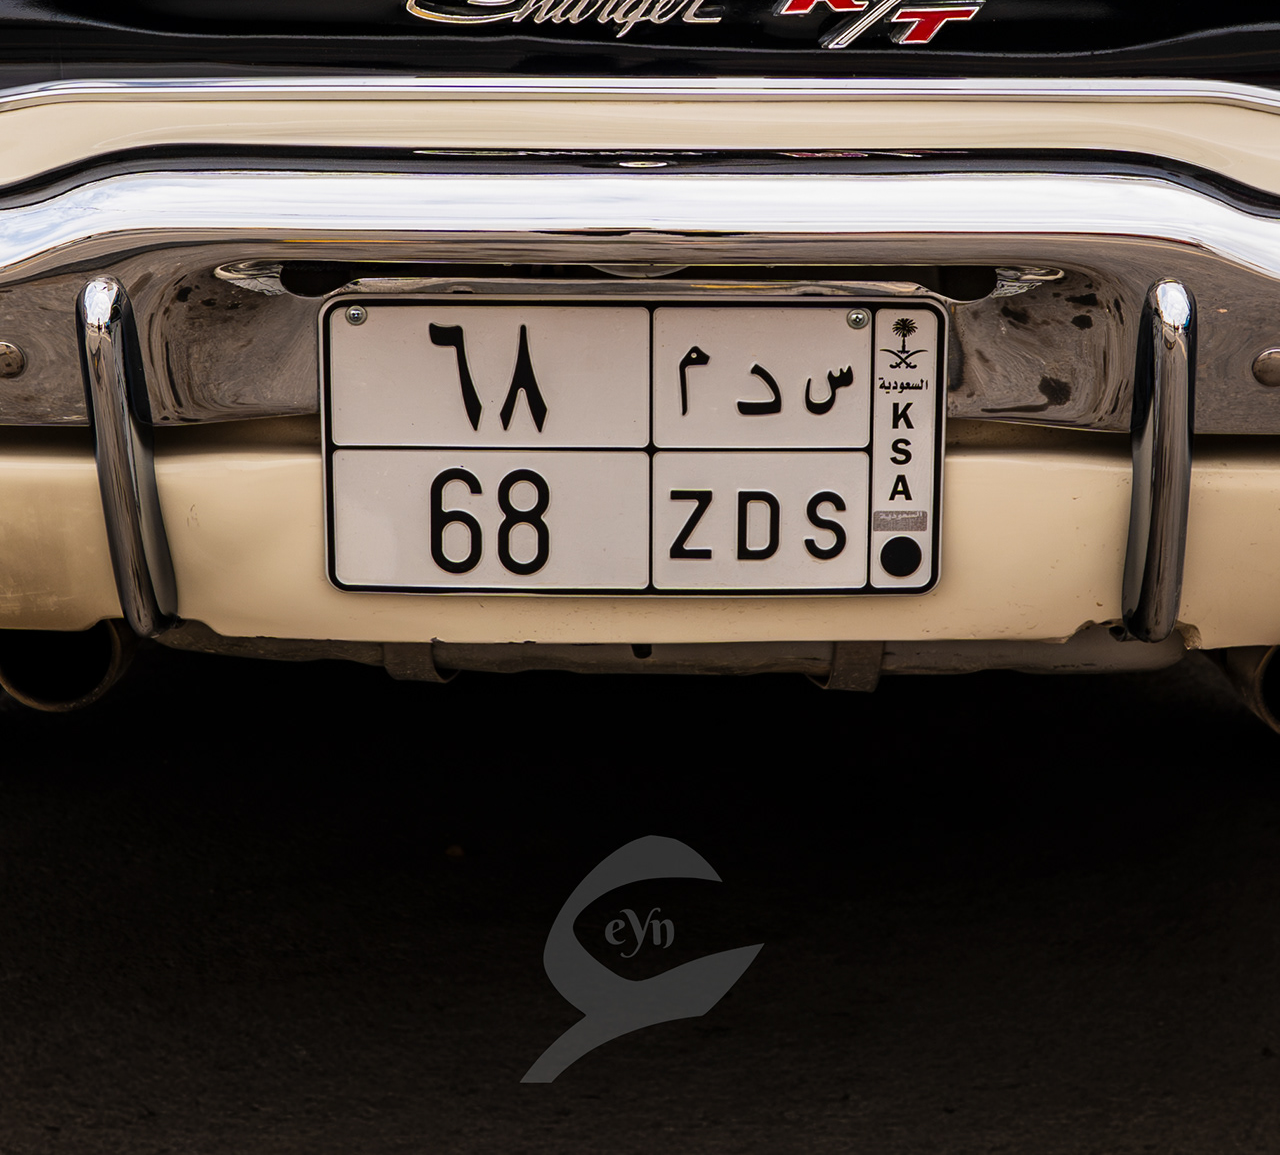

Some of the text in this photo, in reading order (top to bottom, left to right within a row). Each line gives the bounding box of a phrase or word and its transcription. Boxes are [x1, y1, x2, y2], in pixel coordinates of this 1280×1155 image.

[428, 322, 549, 433] ٦٨
[878, 376, 929, 394] السعودية
[430, 467, 550, 576] 68
[669, 489, 847, 561] ZDS
